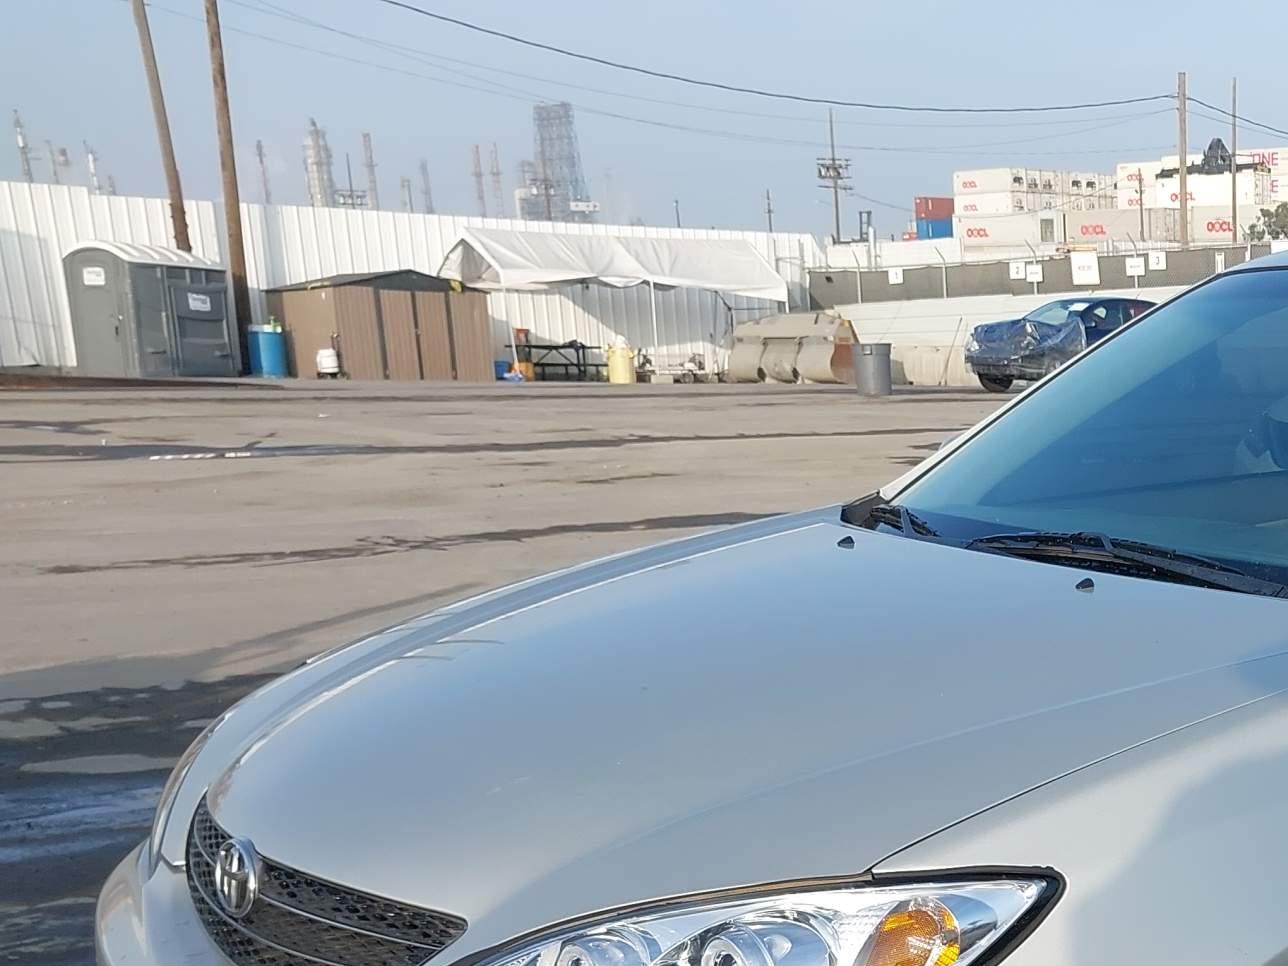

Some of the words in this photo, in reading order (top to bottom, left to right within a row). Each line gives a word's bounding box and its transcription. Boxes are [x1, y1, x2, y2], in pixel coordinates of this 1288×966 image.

[1080, 224, 1106, 236] OOCL
[1207, 221, 1233, 232] OOCL
[966, 228, 989, 238] OOCL
